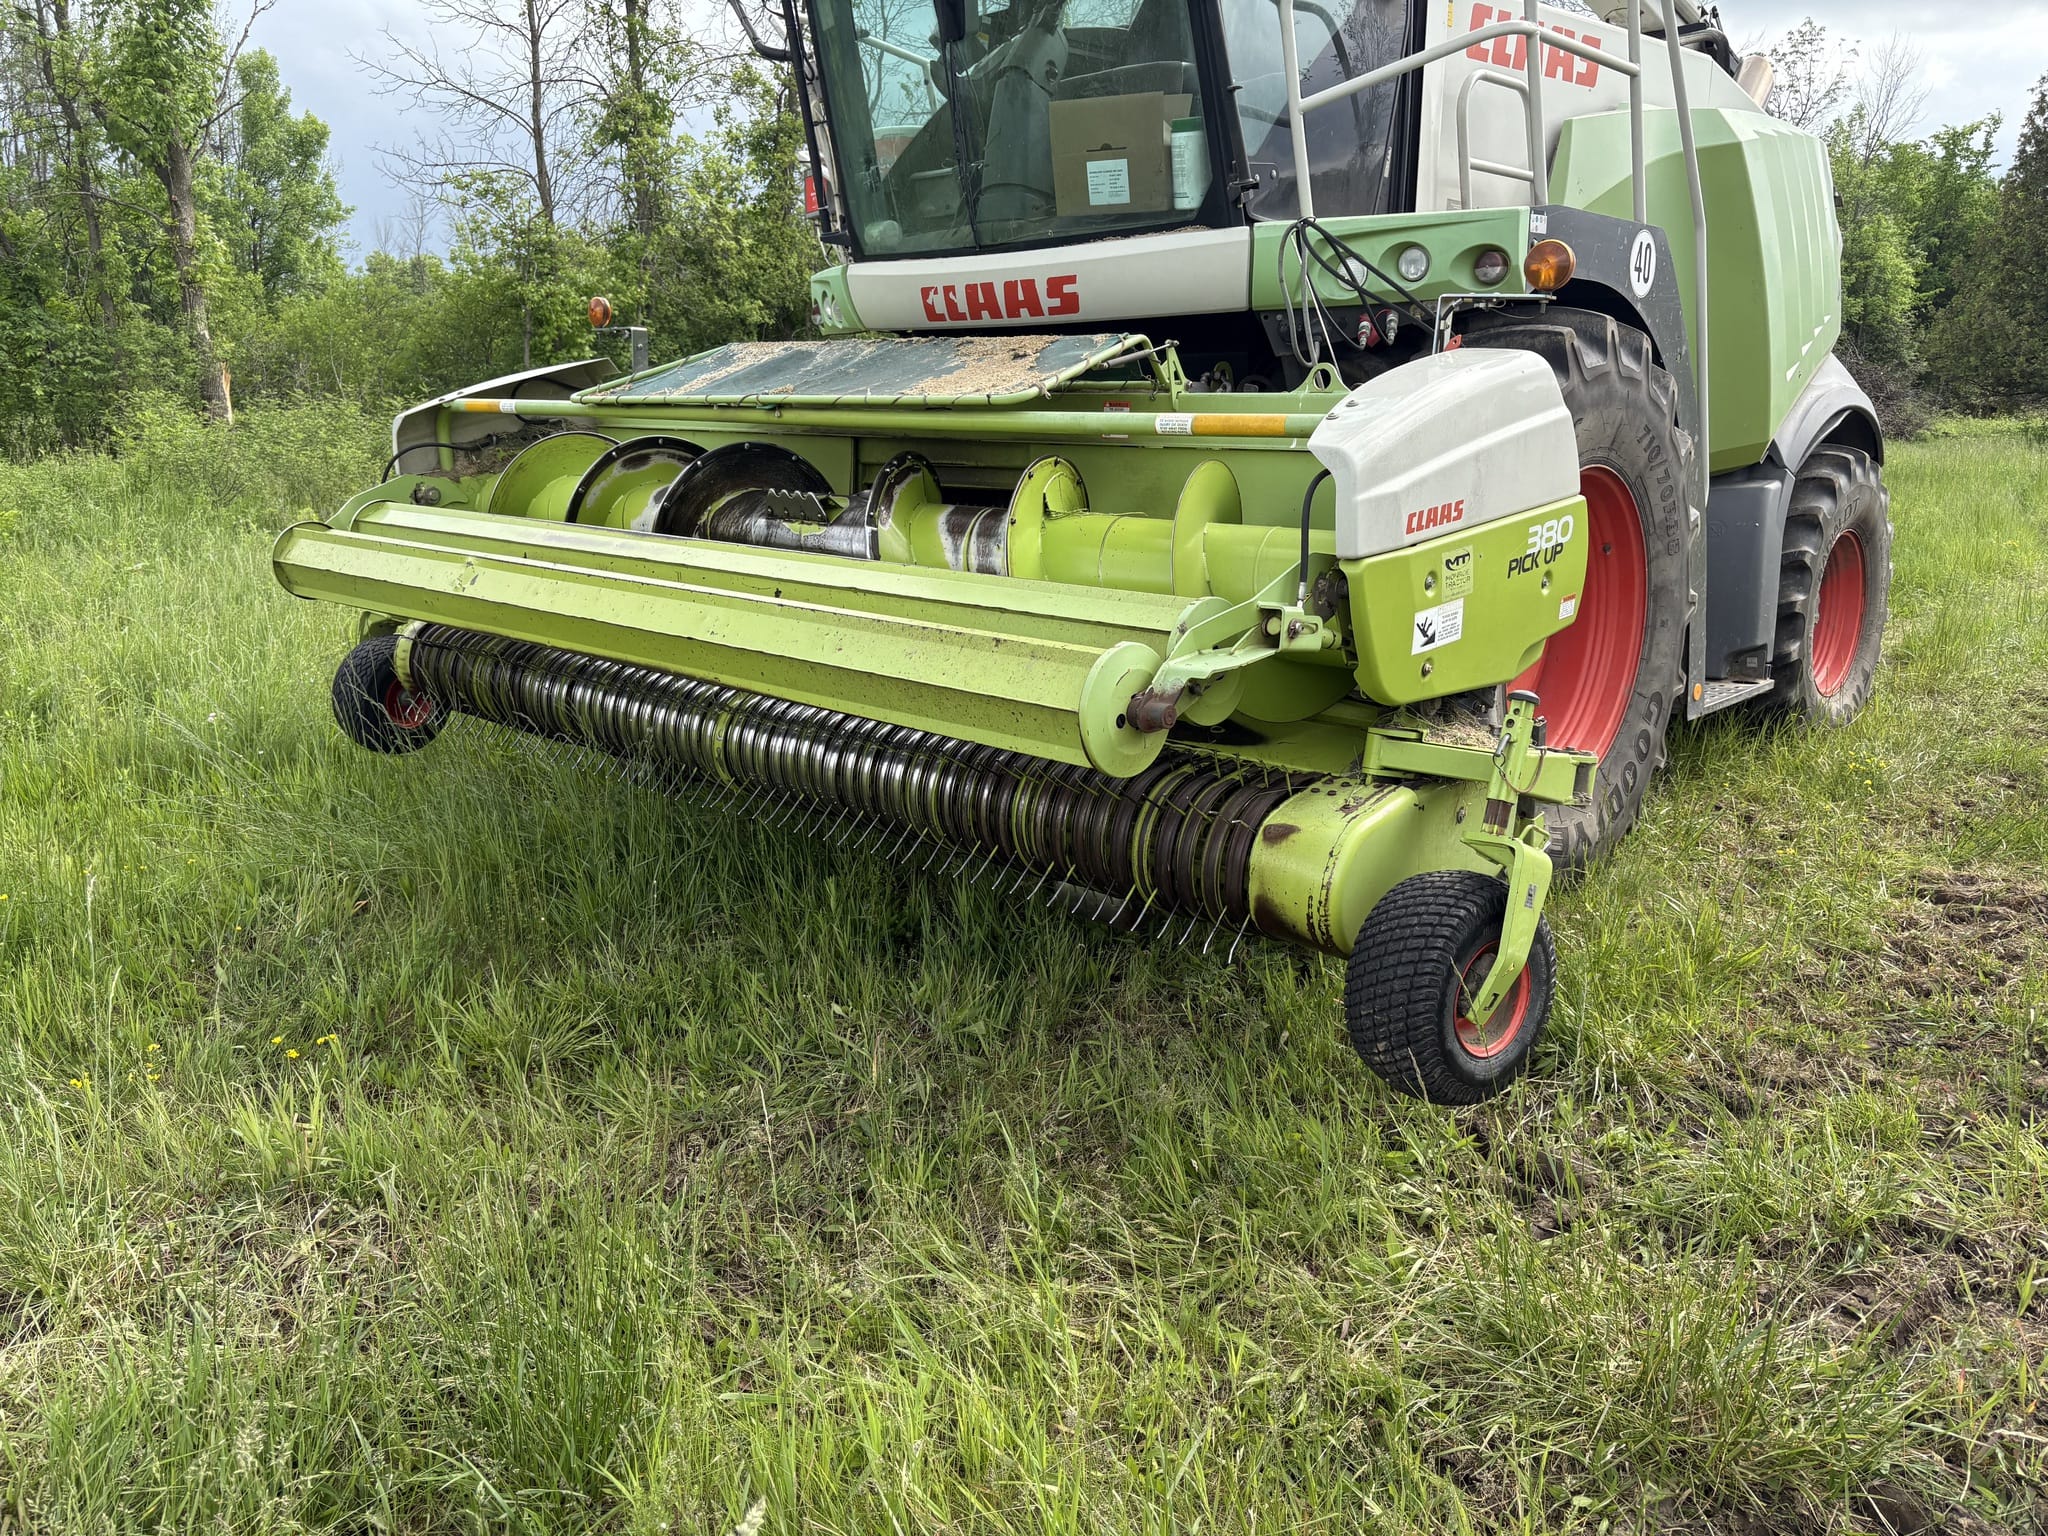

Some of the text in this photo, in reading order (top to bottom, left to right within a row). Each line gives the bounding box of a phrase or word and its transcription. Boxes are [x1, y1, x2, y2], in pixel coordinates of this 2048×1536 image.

[1466, 3, 1601, 88] CLAAS
[1634, 241, 1651, 284] 40
[921, 275, 1079, 322] CLAAS
[1405, 499, 1464, 535] CLAAS
[1526, 514, 1573, 556] 380
[1507, 543, 1564, 579] PICK UP
